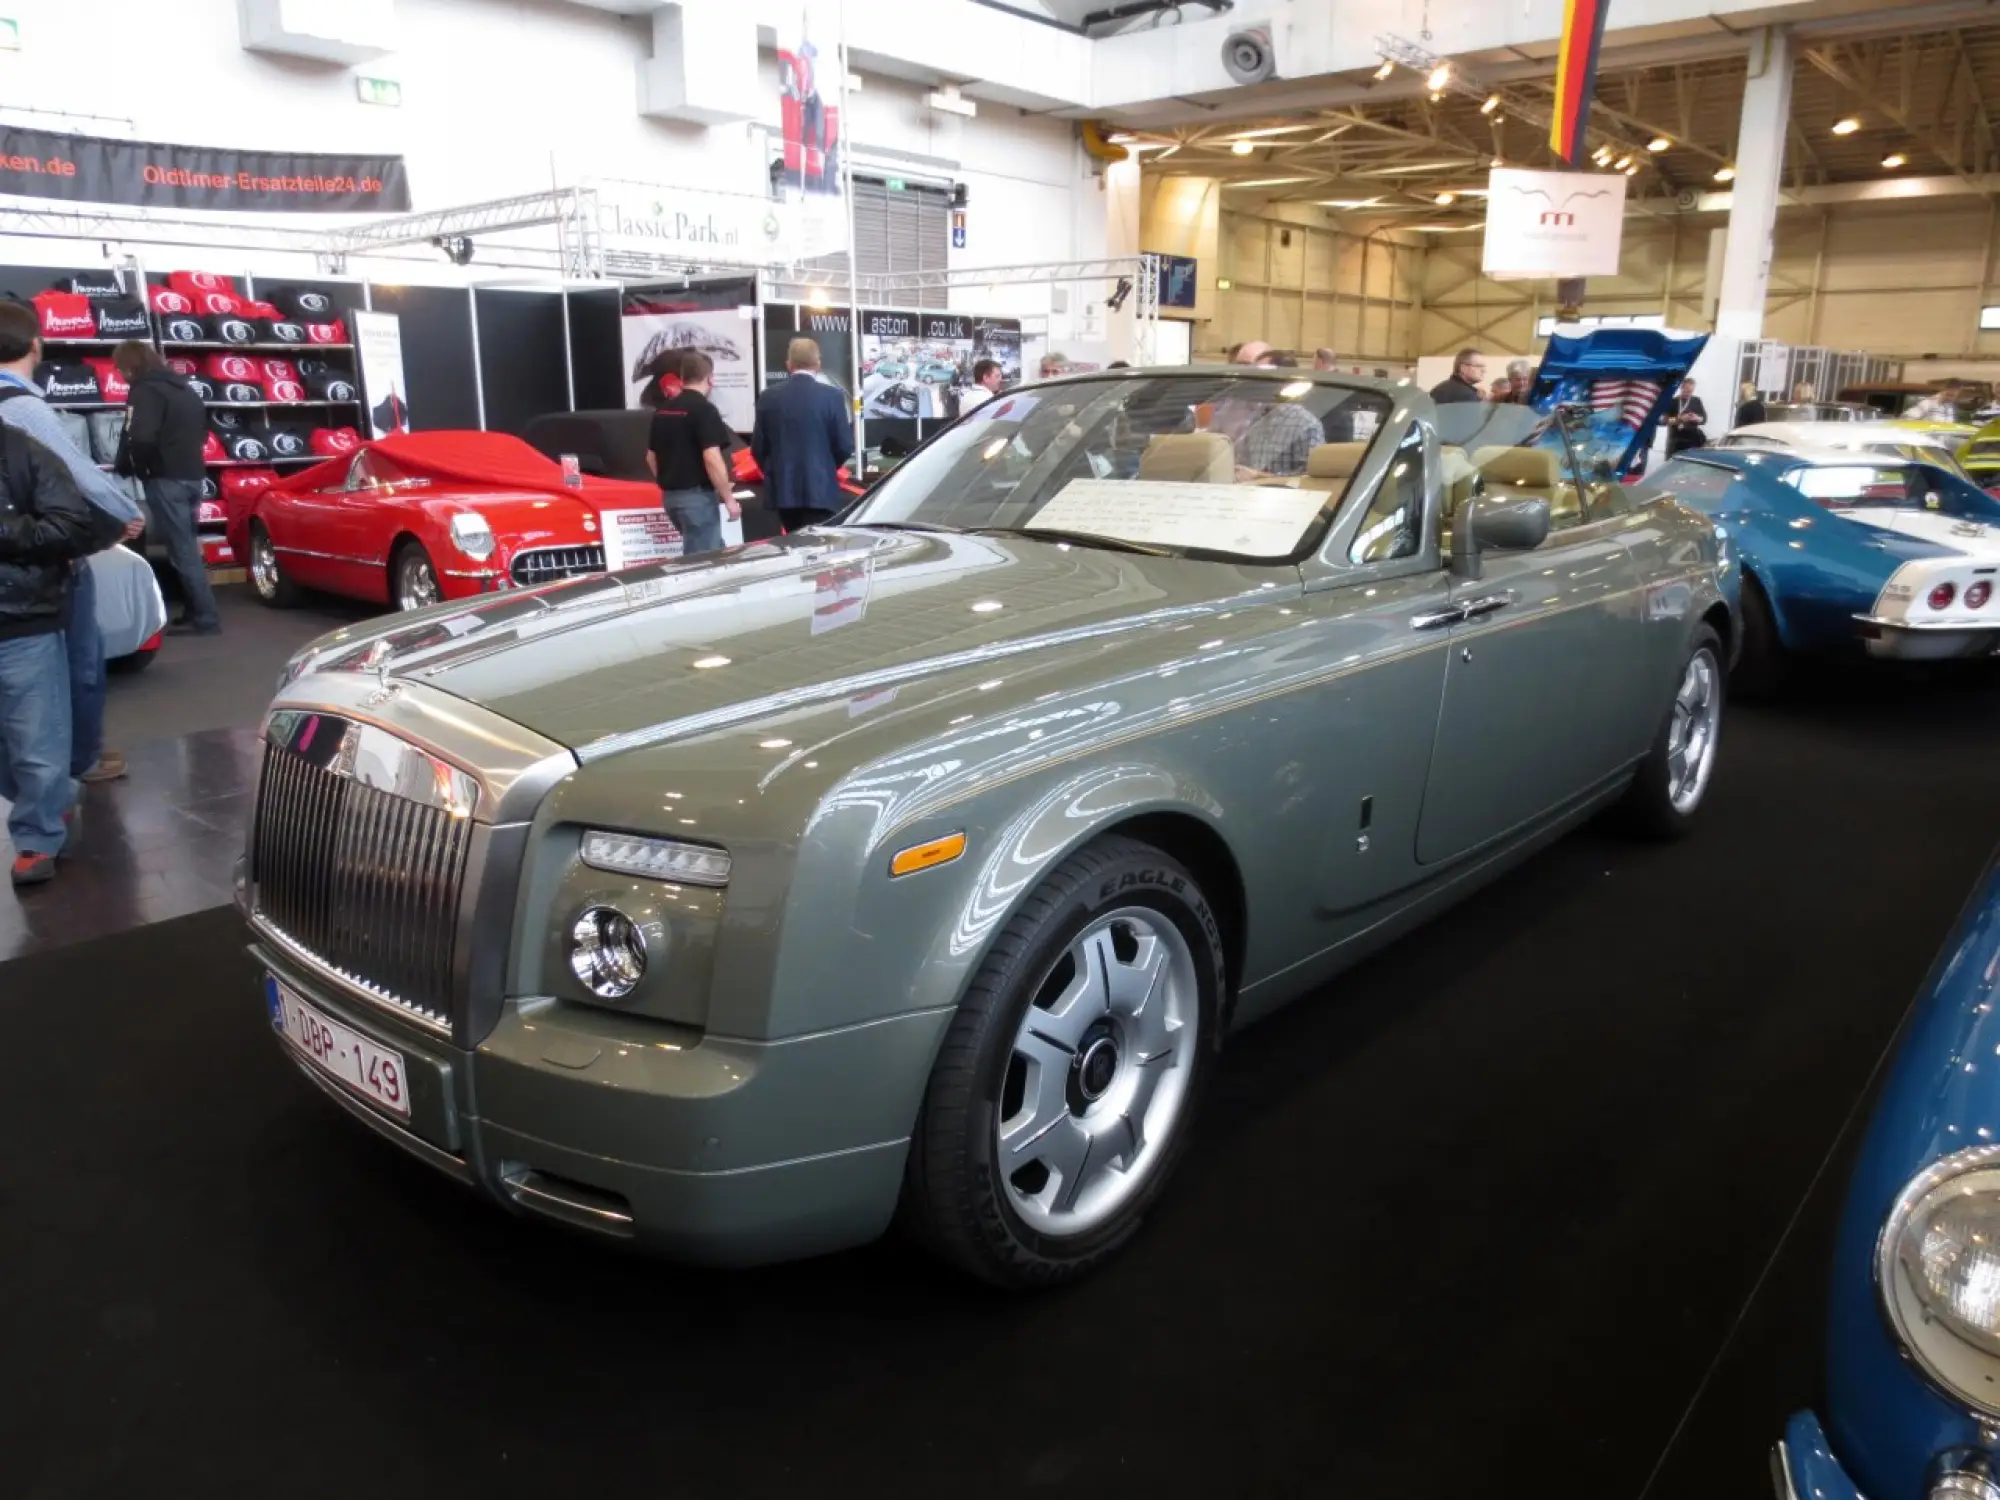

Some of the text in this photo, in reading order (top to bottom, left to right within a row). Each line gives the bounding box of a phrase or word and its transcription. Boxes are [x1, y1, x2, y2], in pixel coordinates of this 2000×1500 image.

[143, 166, 383, 193] Oldtimer-Ersatzteile24.de
[871, 315, 909, 335] aston
[1101, 869, 1185, 896] EAGLE
